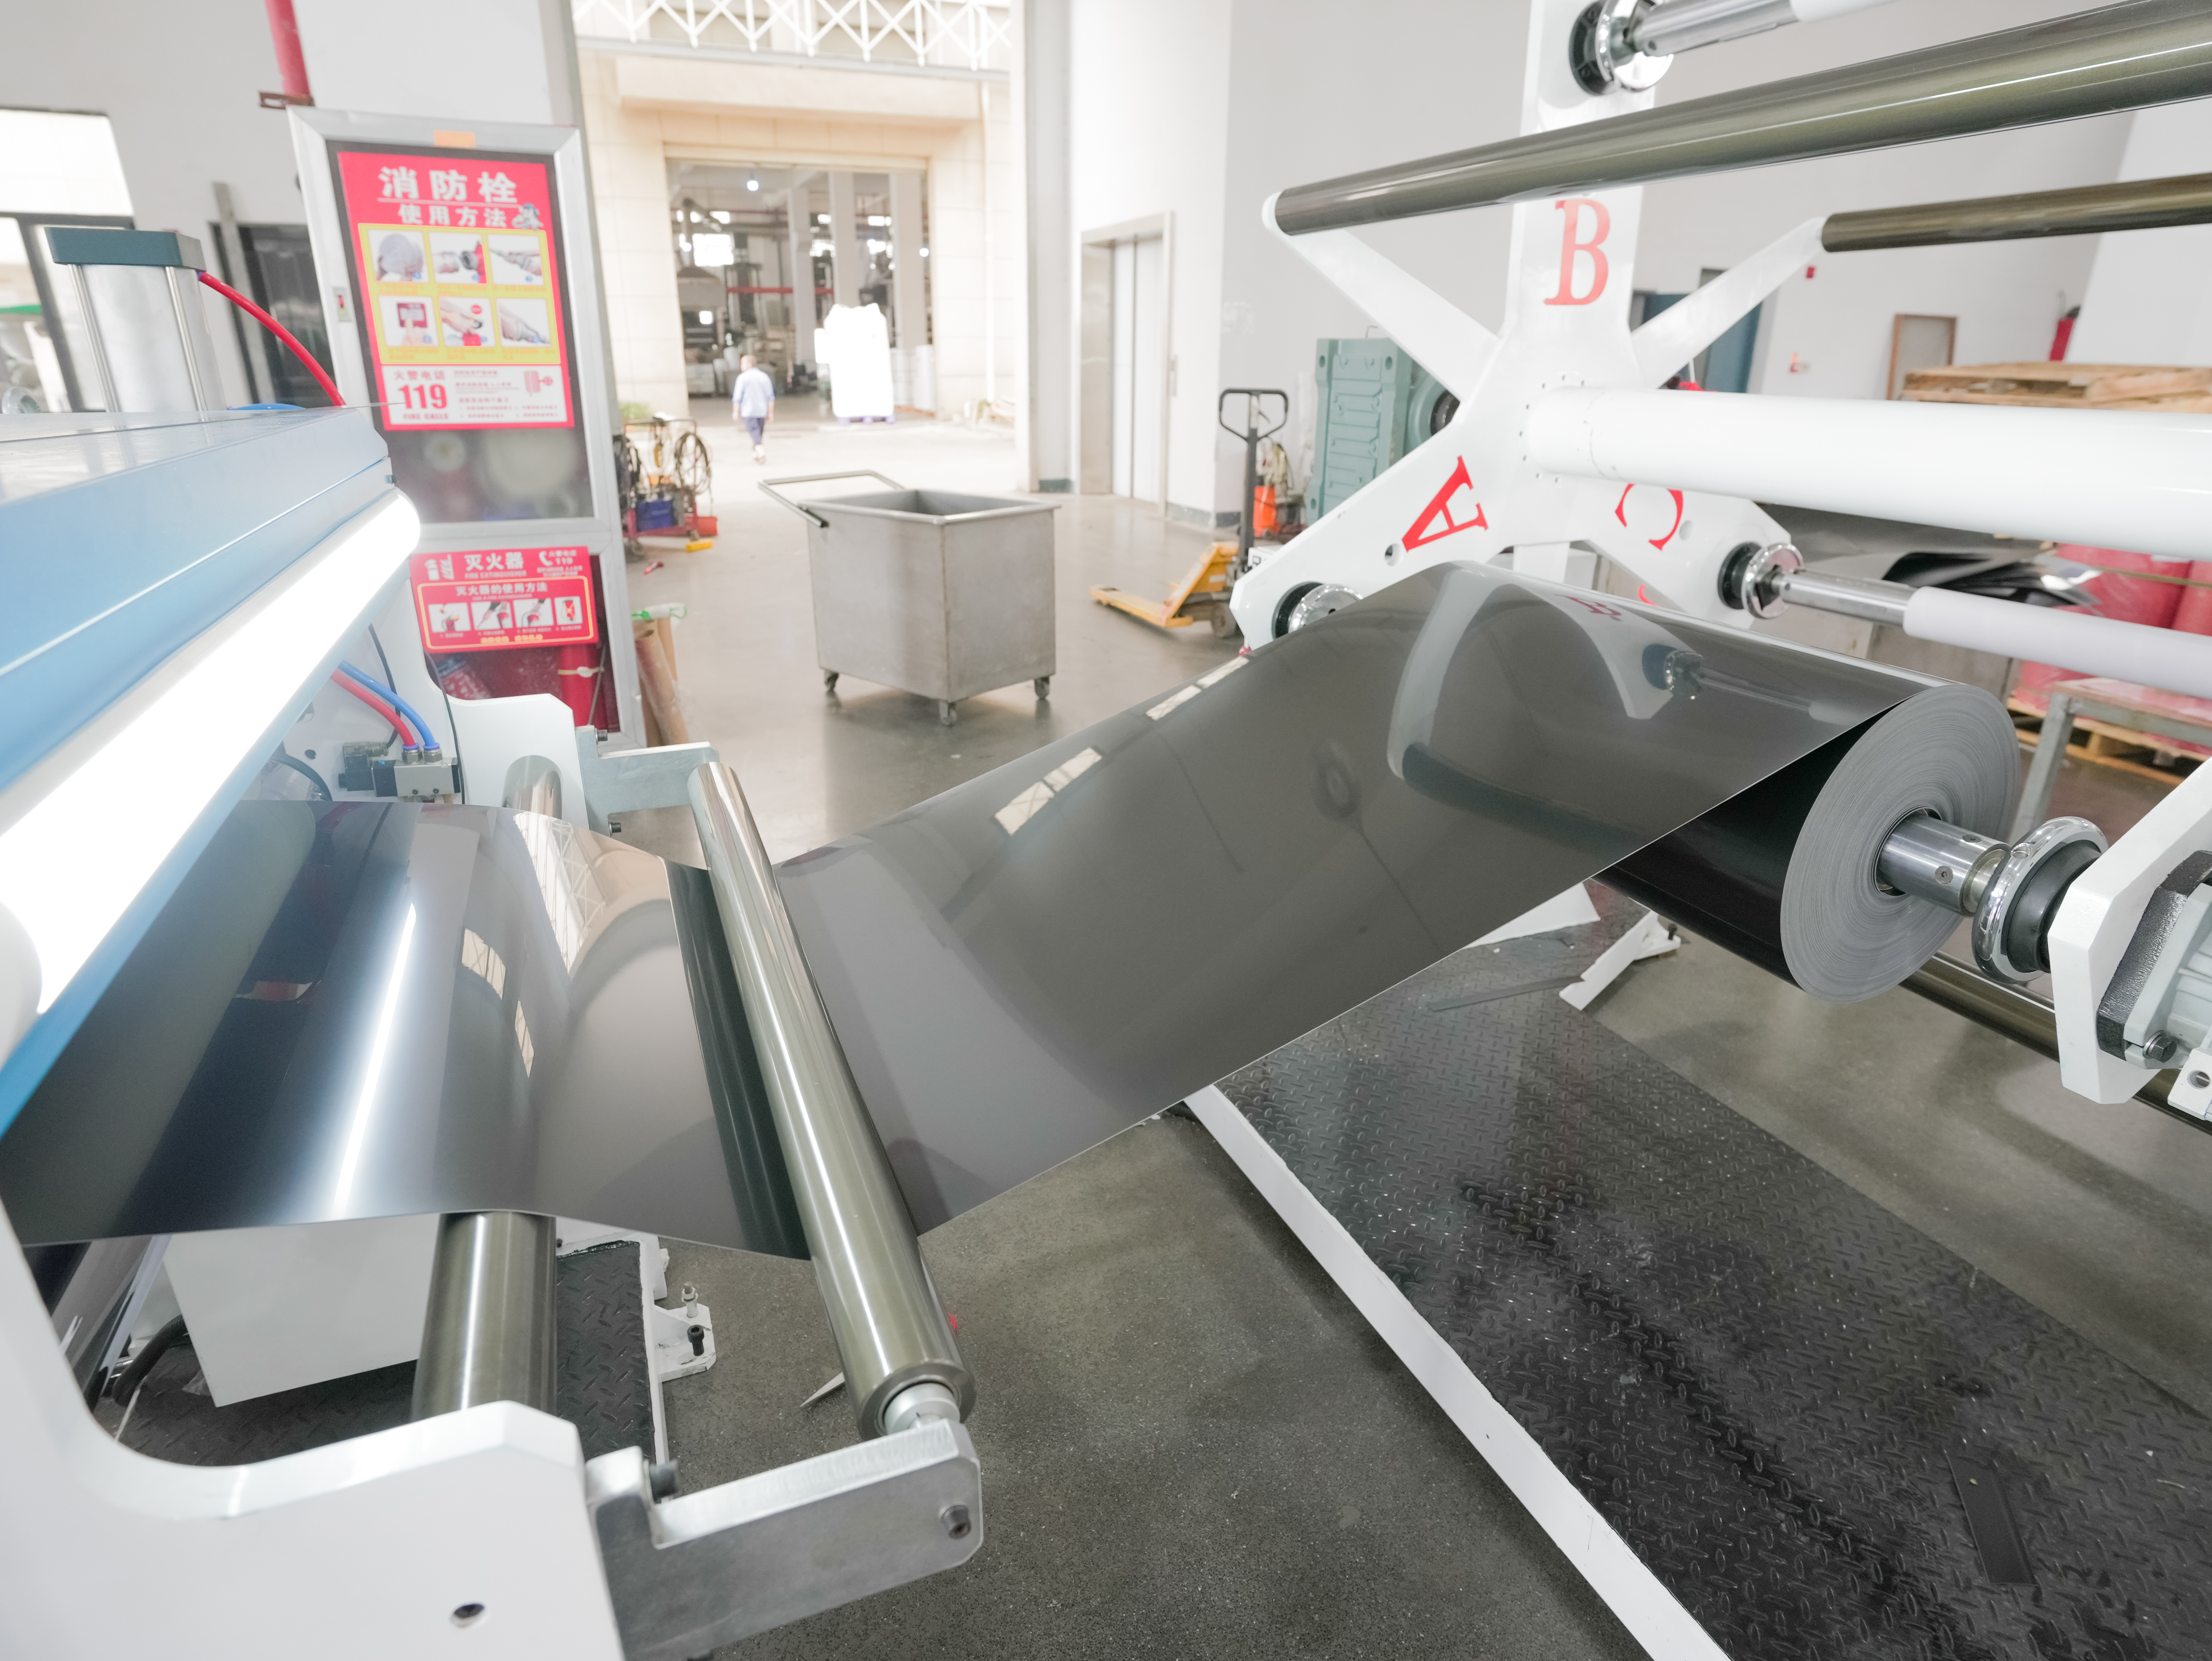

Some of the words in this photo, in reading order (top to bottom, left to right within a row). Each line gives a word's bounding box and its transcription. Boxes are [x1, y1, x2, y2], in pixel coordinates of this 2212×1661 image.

[378, 166, 518, 203] 消防栓
[398, 203, 507, 228] 使用方法
[1544, 199, 1610, 305] B
[394, 370, 445, 381] 火警电话
[399, 384, 447, 409] 119
[1402, 455, 1488, 552] A
[464, 552, 524, 571] 灭火器
[455, 581, 548, 596] 灭火器的使用方法
